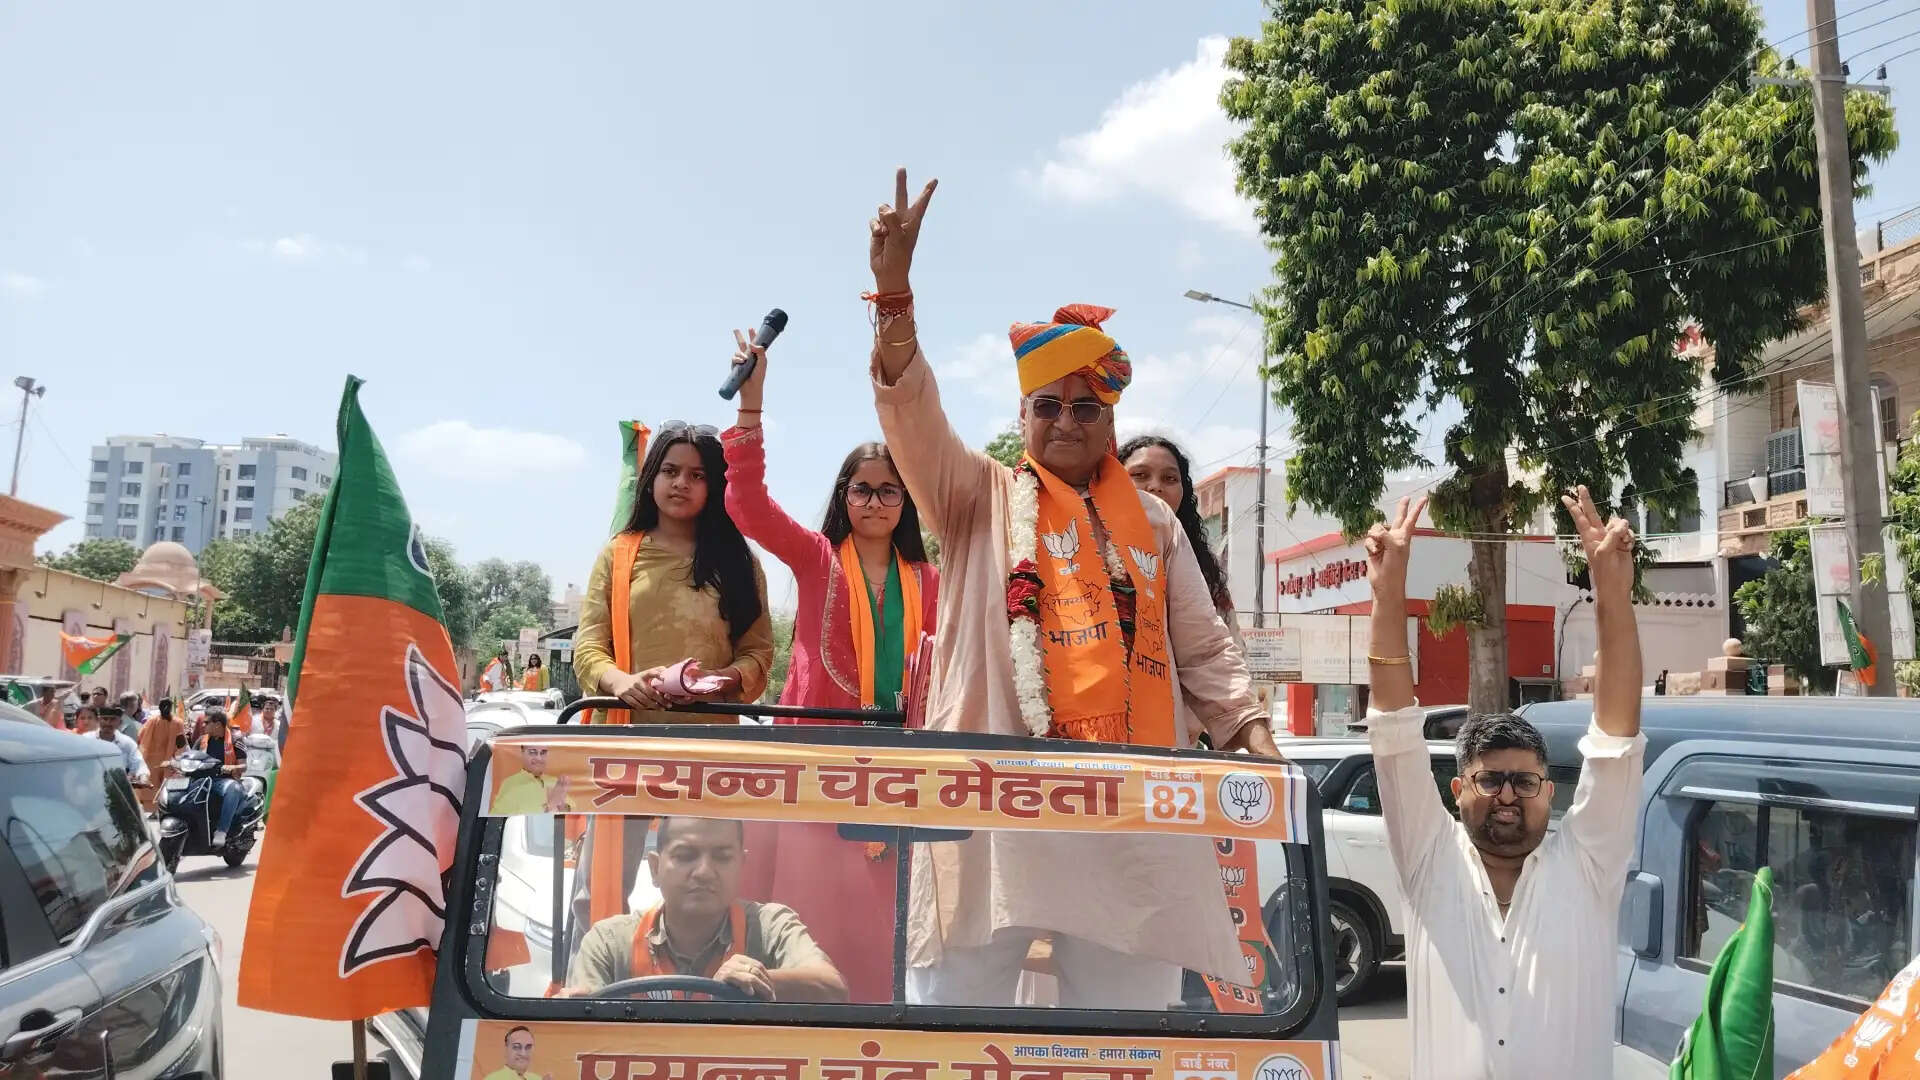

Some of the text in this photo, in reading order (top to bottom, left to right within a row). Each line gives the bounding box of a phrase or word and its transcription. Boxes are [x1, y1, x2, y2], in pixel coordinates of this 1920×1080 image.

[1048, 621, 1108, 647] भाजपा
[1136, 651, 1166, 680] भाजपा
[589, 756, 1125, 819] प्रसन्न चंद मेहता
[1151, 785, 1199, 820] 82
[1013, 1045, 1050, 1058] आपका
[1051, 1045, 1089, 1059] विश्वास
[1099, 1047, 1126, 1060] हमारा
[1128, 1046, 1161, 1061] संकल्प
